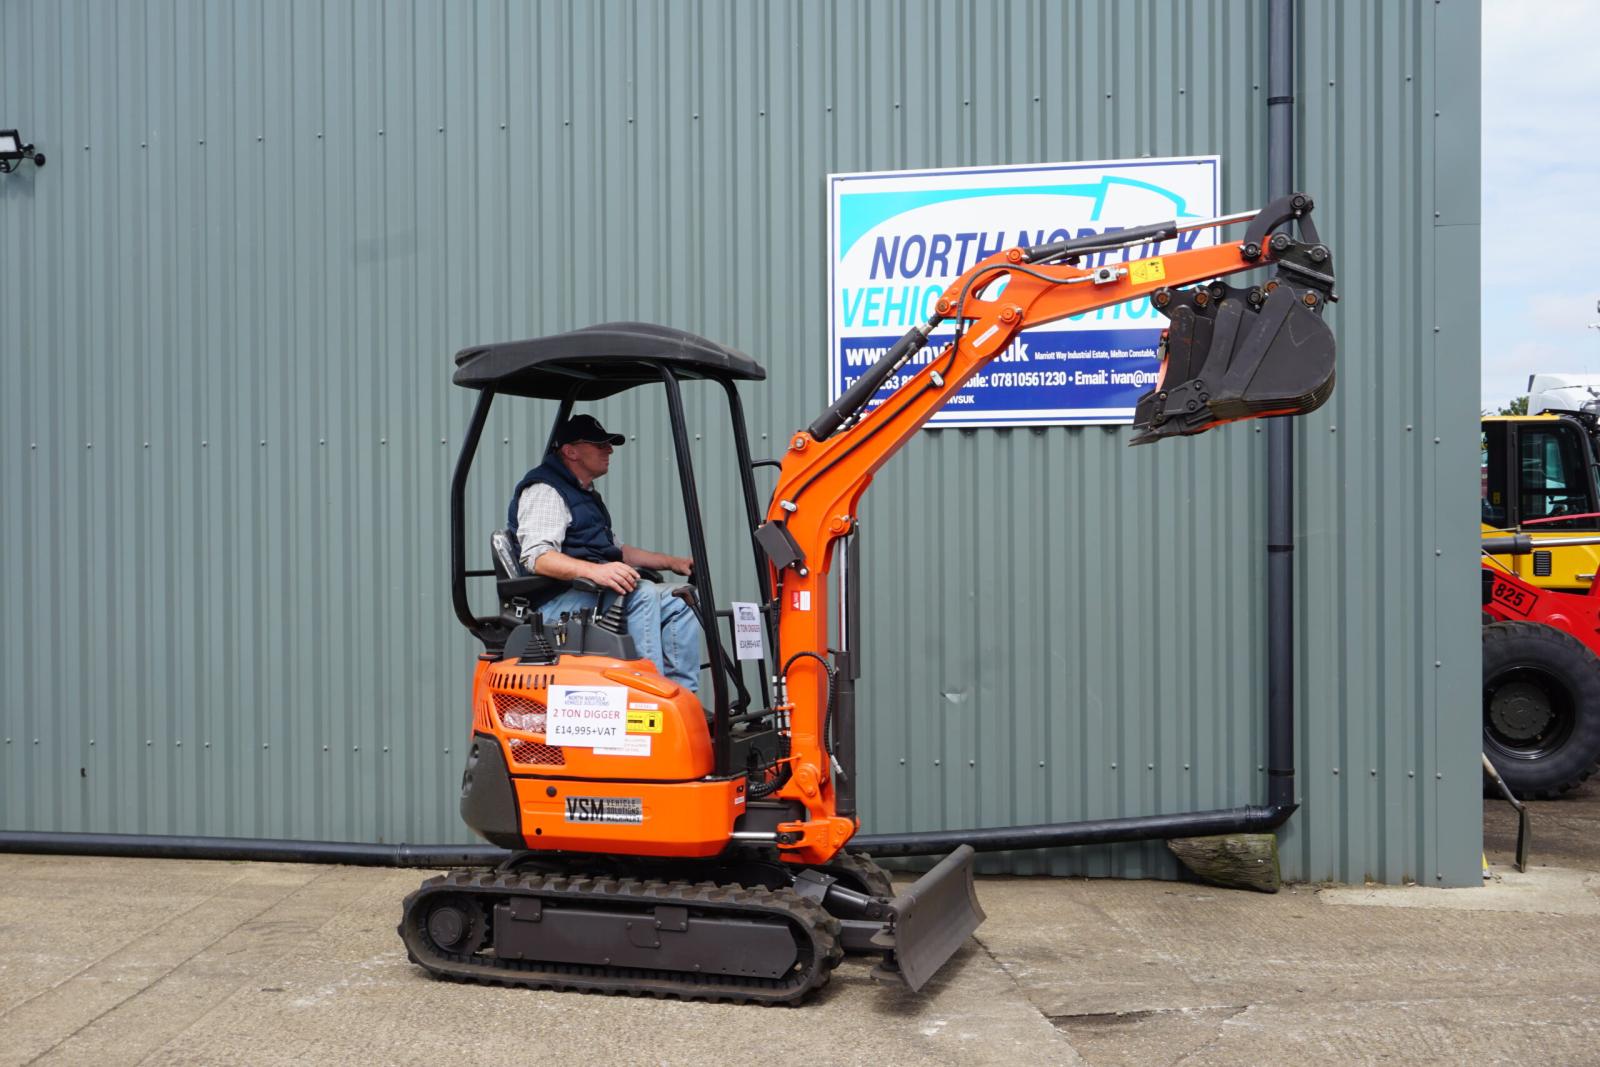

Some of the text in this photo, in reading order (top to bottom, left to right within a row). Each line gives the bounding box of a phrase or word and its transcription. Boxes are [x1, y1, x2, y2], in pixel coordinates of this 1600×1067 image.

[869, 231, 1005, 280] NORTH
[1035, 351, 1055, 360] Marriott
[1056, 351, 1067, 361] Way
[1067, 350, 1092, 359] Industrial
[1092, 350, 1110, 359] Estate,
[1129, 348, 1157, 358] Constable,
[991, 371, 1067, 387] 07810561230
[1075, 370, 1108, 385] Email:
[1494, 582, 1525, 607] 825
[553, 709, 620, 719] 2 TON DIGGER
[555, 726, 616, 736] £14,995+VAT
[566, 798, 603, 821] VSM
